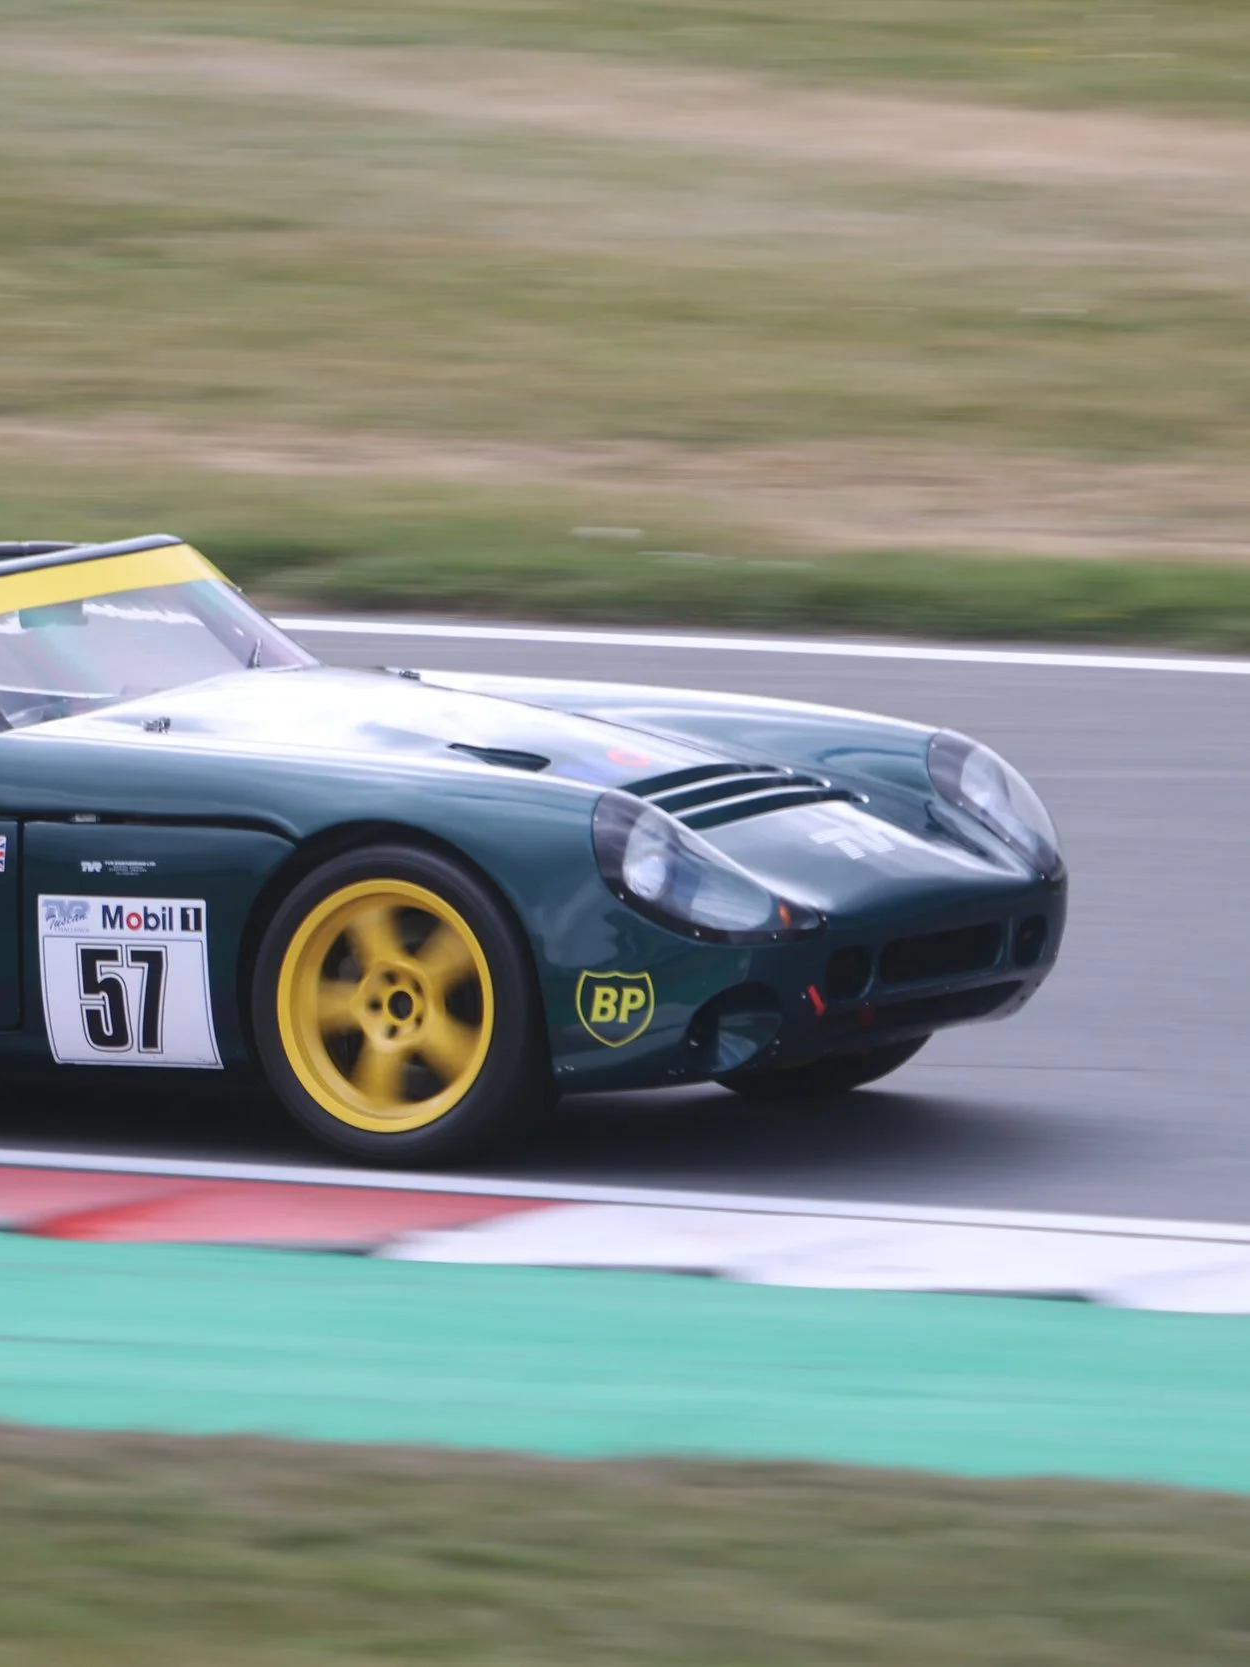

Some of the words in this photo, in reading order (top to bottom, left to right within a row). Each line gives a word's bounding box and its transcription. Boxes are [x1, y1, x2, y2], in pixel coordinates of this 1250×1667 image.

[101, 905, 173, 932] Mobil
[184, 907, 199, 932] 1
[77, 944, 167, 1053] 57
[591, 986, 646, 1023] BP
